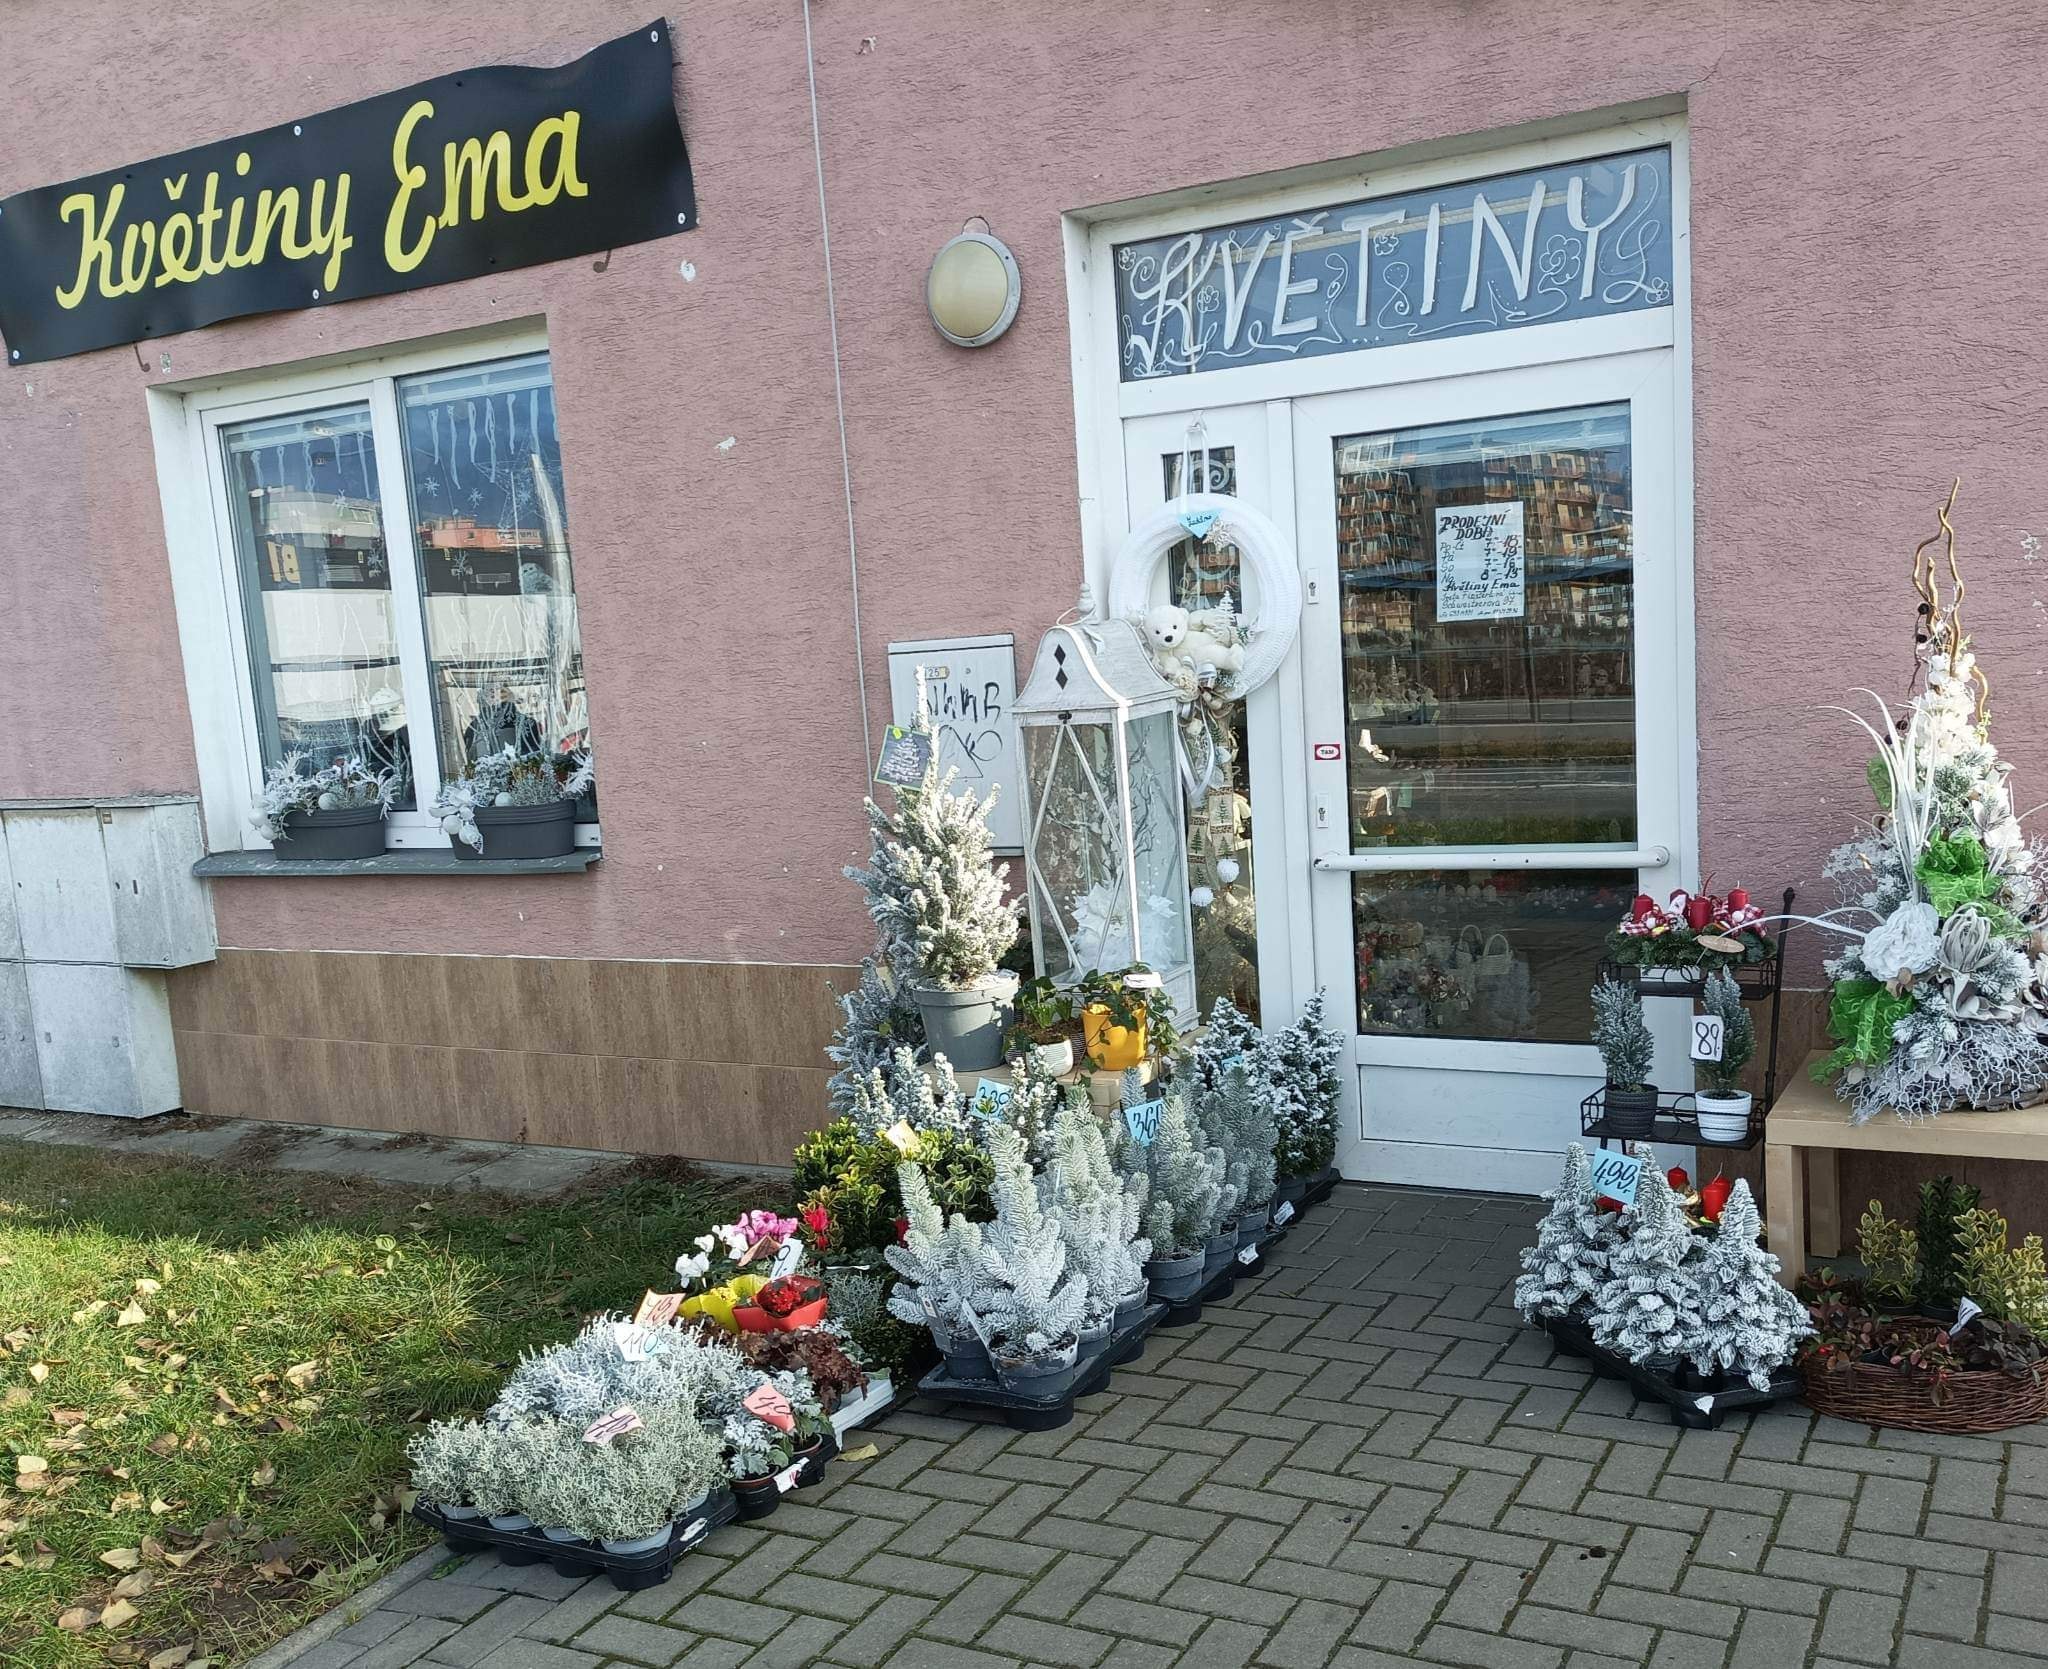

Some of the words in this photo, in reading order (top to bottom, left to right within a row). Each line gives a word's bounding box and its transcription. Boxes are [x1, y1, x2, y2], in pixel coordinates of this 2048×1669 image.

[56, 152, 353, 309] Květiny
[385, 100, 588, 273] Ema
[1131, 164, 1636, 374] KVĚTINY
